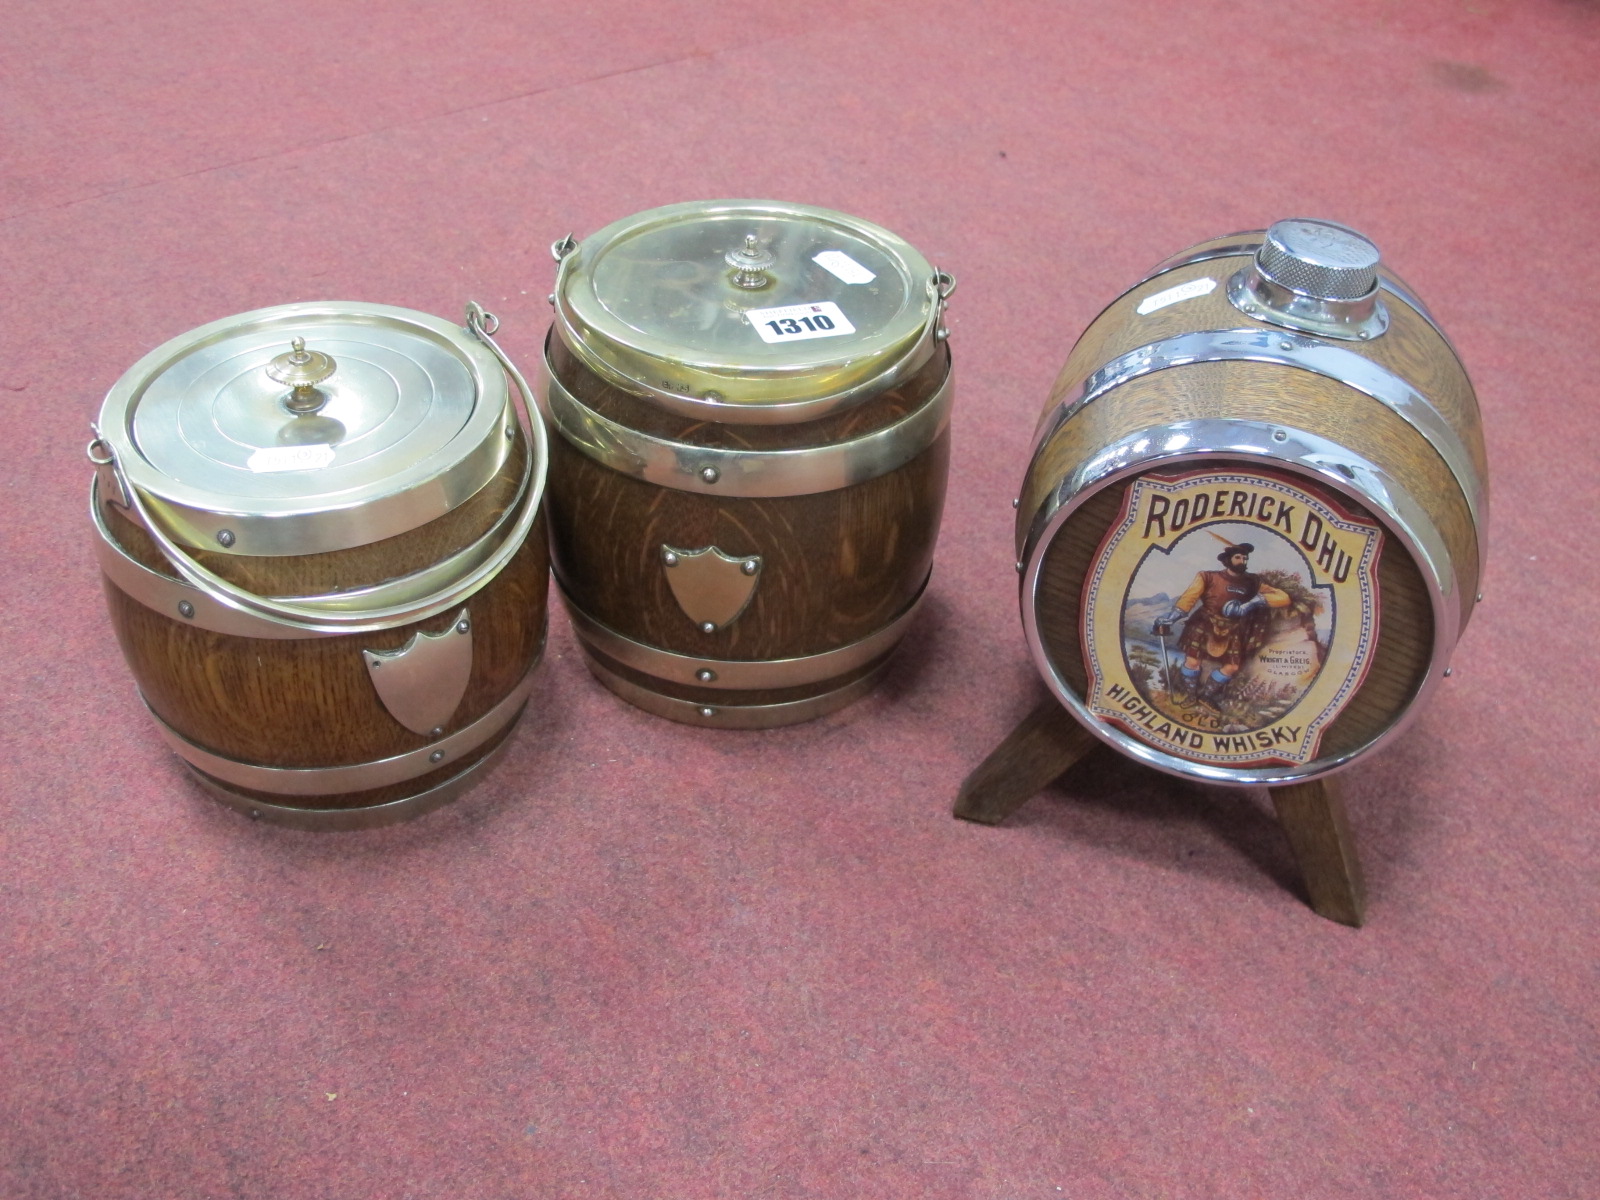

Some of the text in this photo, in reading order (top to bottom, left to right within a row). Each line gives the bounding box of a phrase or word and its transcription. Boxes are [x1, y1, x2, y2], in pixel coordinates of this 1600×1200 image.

[765, 315, 836, 336] 1310
[1143, 490, 1353, 583] RODERICK DHU
[1106, 684, 1302, 753] HIGHLAND WHISKY
